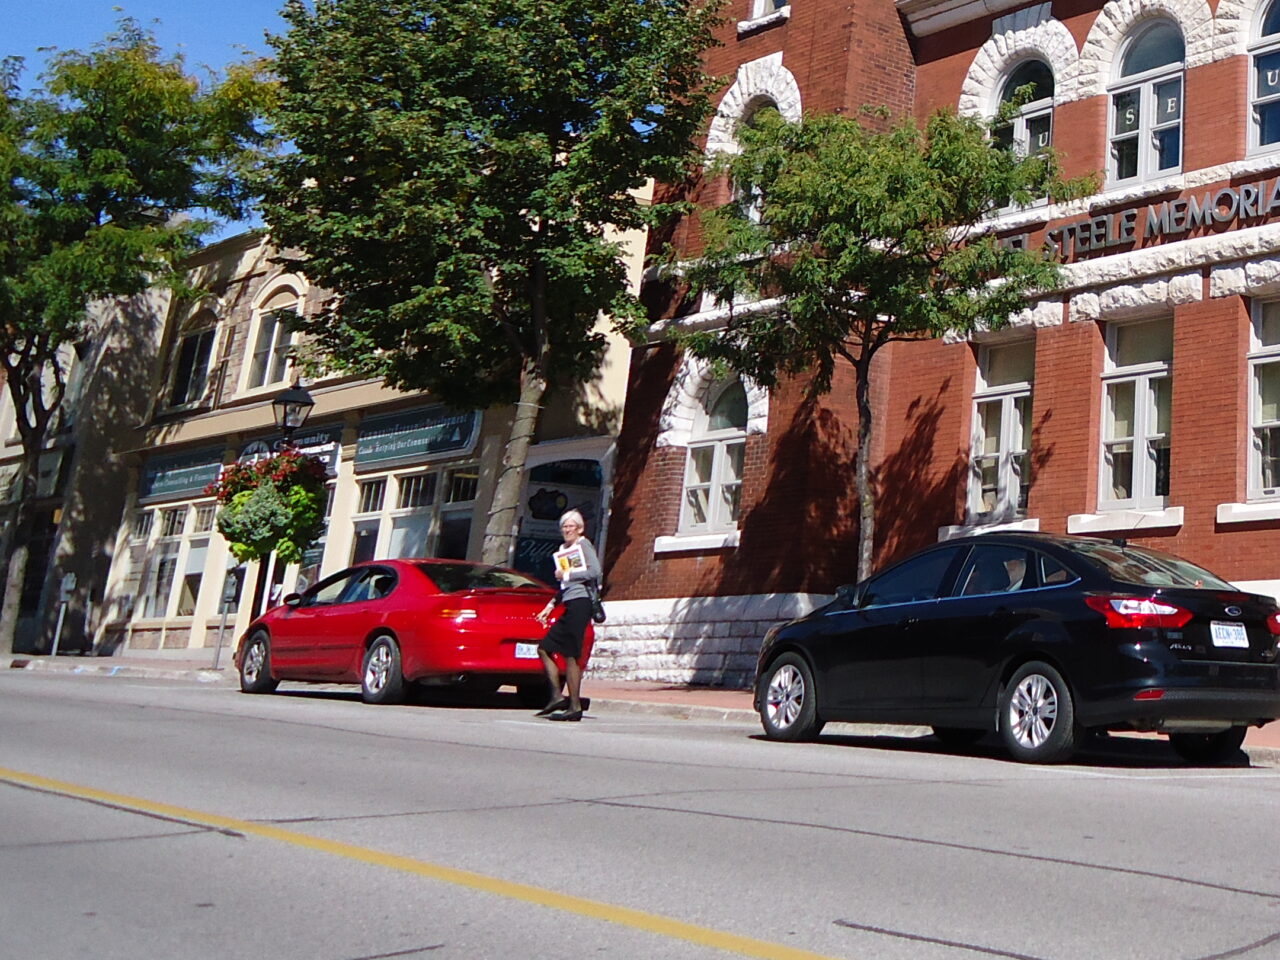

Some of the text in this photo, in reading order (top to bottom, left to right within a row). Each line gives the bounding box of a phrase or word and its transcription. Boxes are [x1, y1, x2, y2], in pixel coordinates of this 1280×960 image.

[1125, 108, 1135, 125] S
[1166, 97, 1177, 113] E
[1266, 69, 1280, 86] U
[1043, 208, 1138, 261] STEELE
